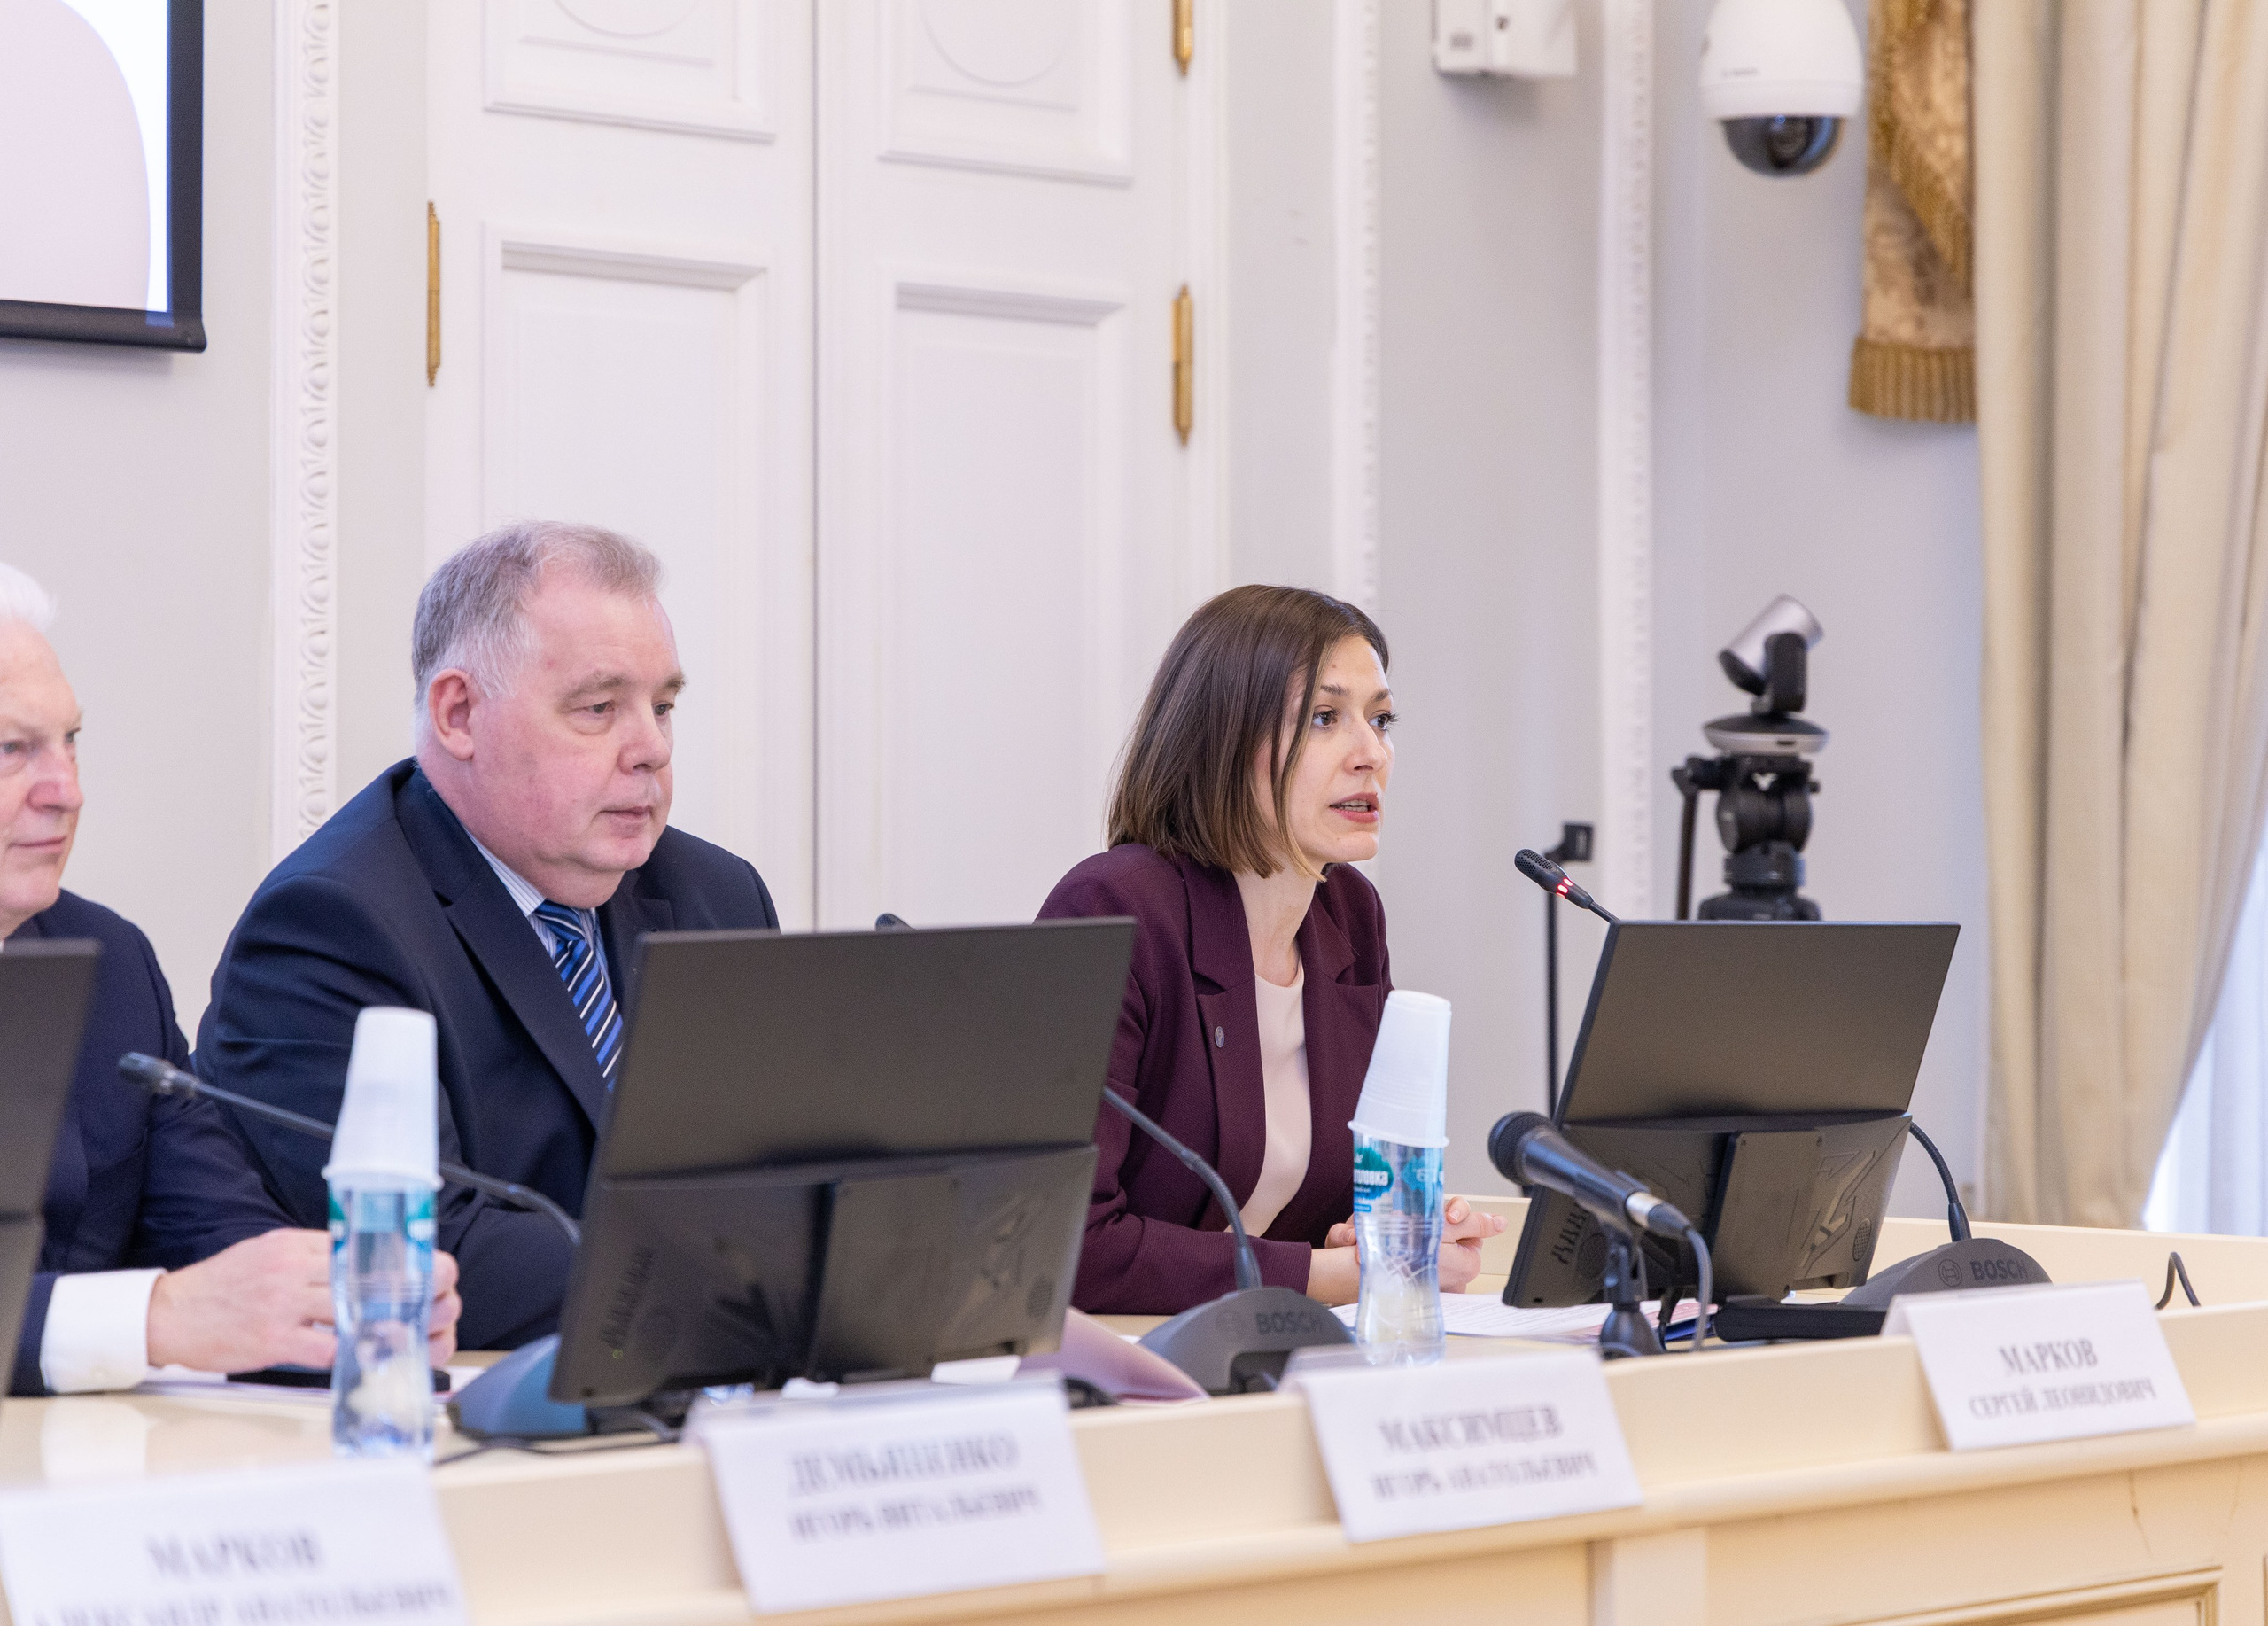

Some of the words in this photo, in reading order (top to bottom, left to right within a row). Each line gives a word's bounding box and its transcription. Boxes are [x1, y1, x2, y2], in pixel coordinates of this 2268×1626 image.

[1969, 1260, 2030, 1281] BOSCH
[1255, 1311, 1324, 1335] BOSCH
[1998, 1339, 2099, 1374] МАРКОВ
[1968, 1386, 2037, 1418] СЕРГЕЙ
[2041, 1378, 2158, 1410] ЛЕОНИДОВИЧ
